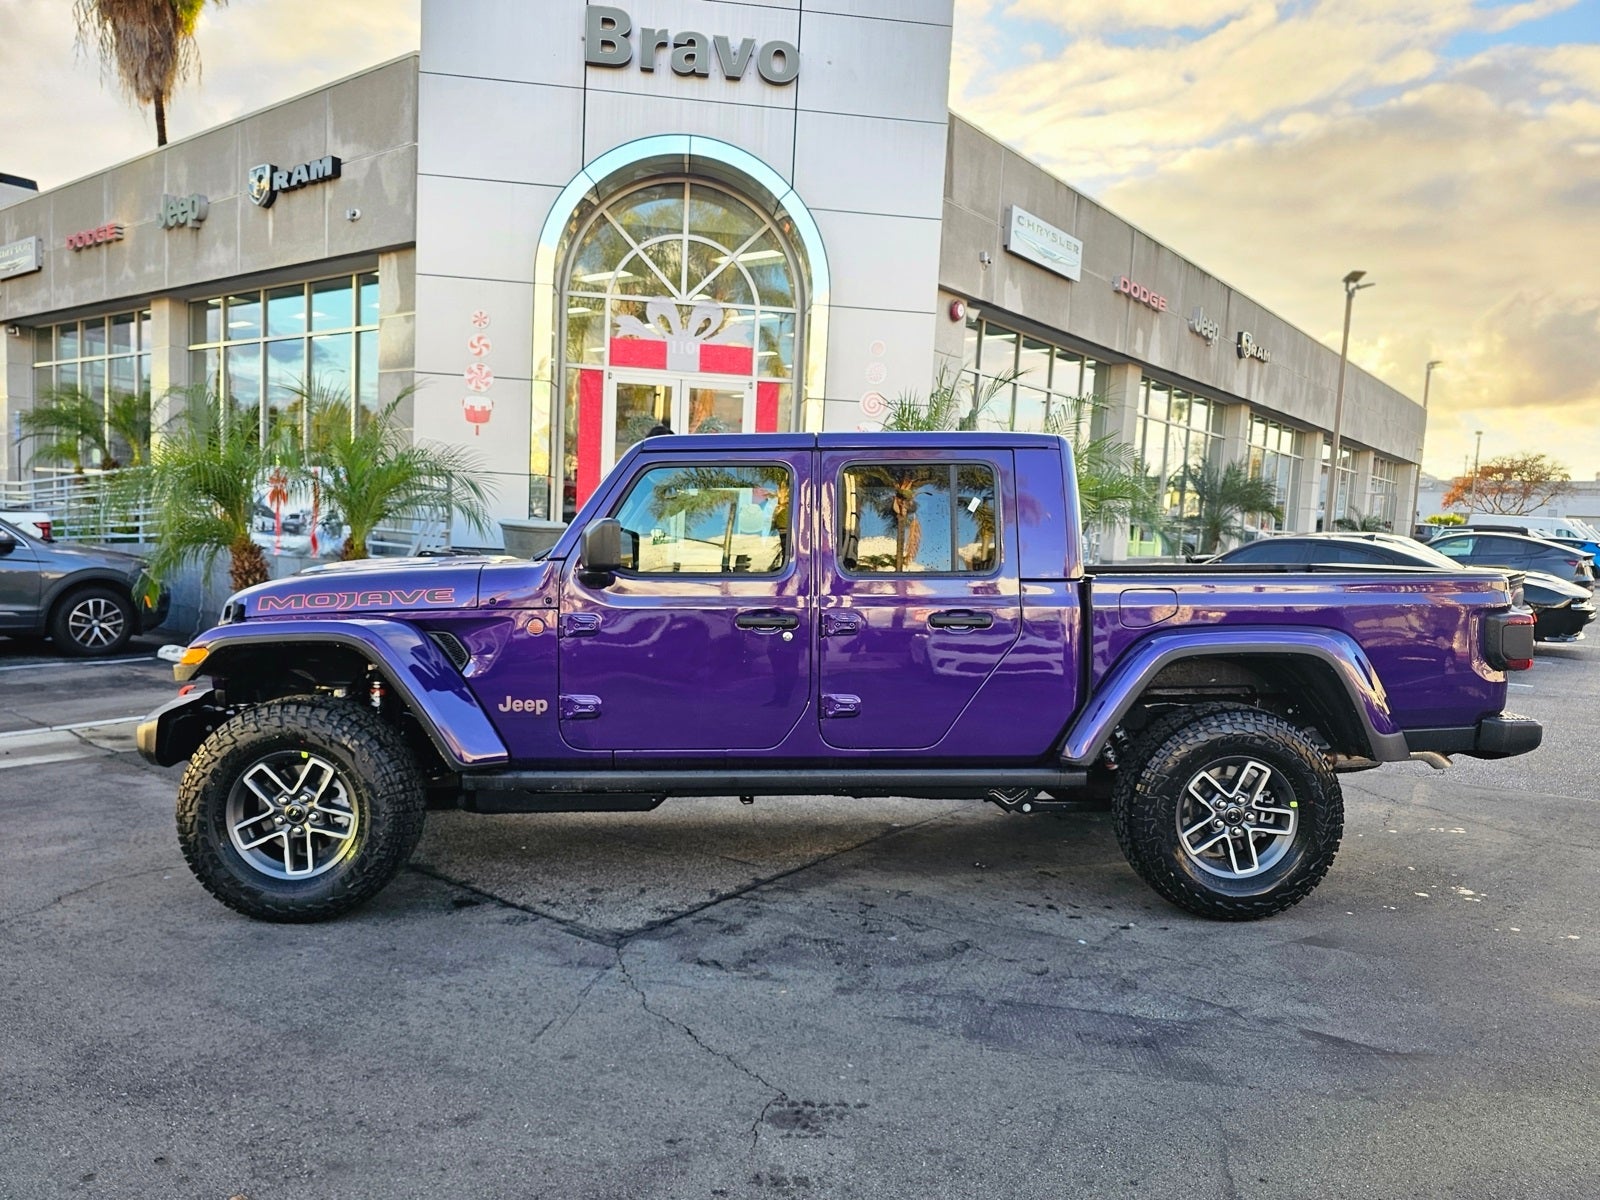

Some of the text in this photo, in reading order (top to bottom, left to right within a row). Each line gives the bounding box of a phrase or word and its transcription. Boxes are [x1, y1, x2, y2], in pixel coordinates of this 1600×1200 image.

[586, 5, 800, 85] Bravo
[272, 156, 336, 191] RAM
[157, 193, 206, 230] Jeep
[65, 223, 121, 251] DODGE
[1017, 214, 1079, 255] CHRYSLER
[1119, 277, 1167, 312] DODGE
[1192, 305, 1219, 346] Jeep
[1251, 344, 1271, 362] RAM
[257, 588, 455, 612] MOJAVE
[498, 695, 548, 715] Jeep
